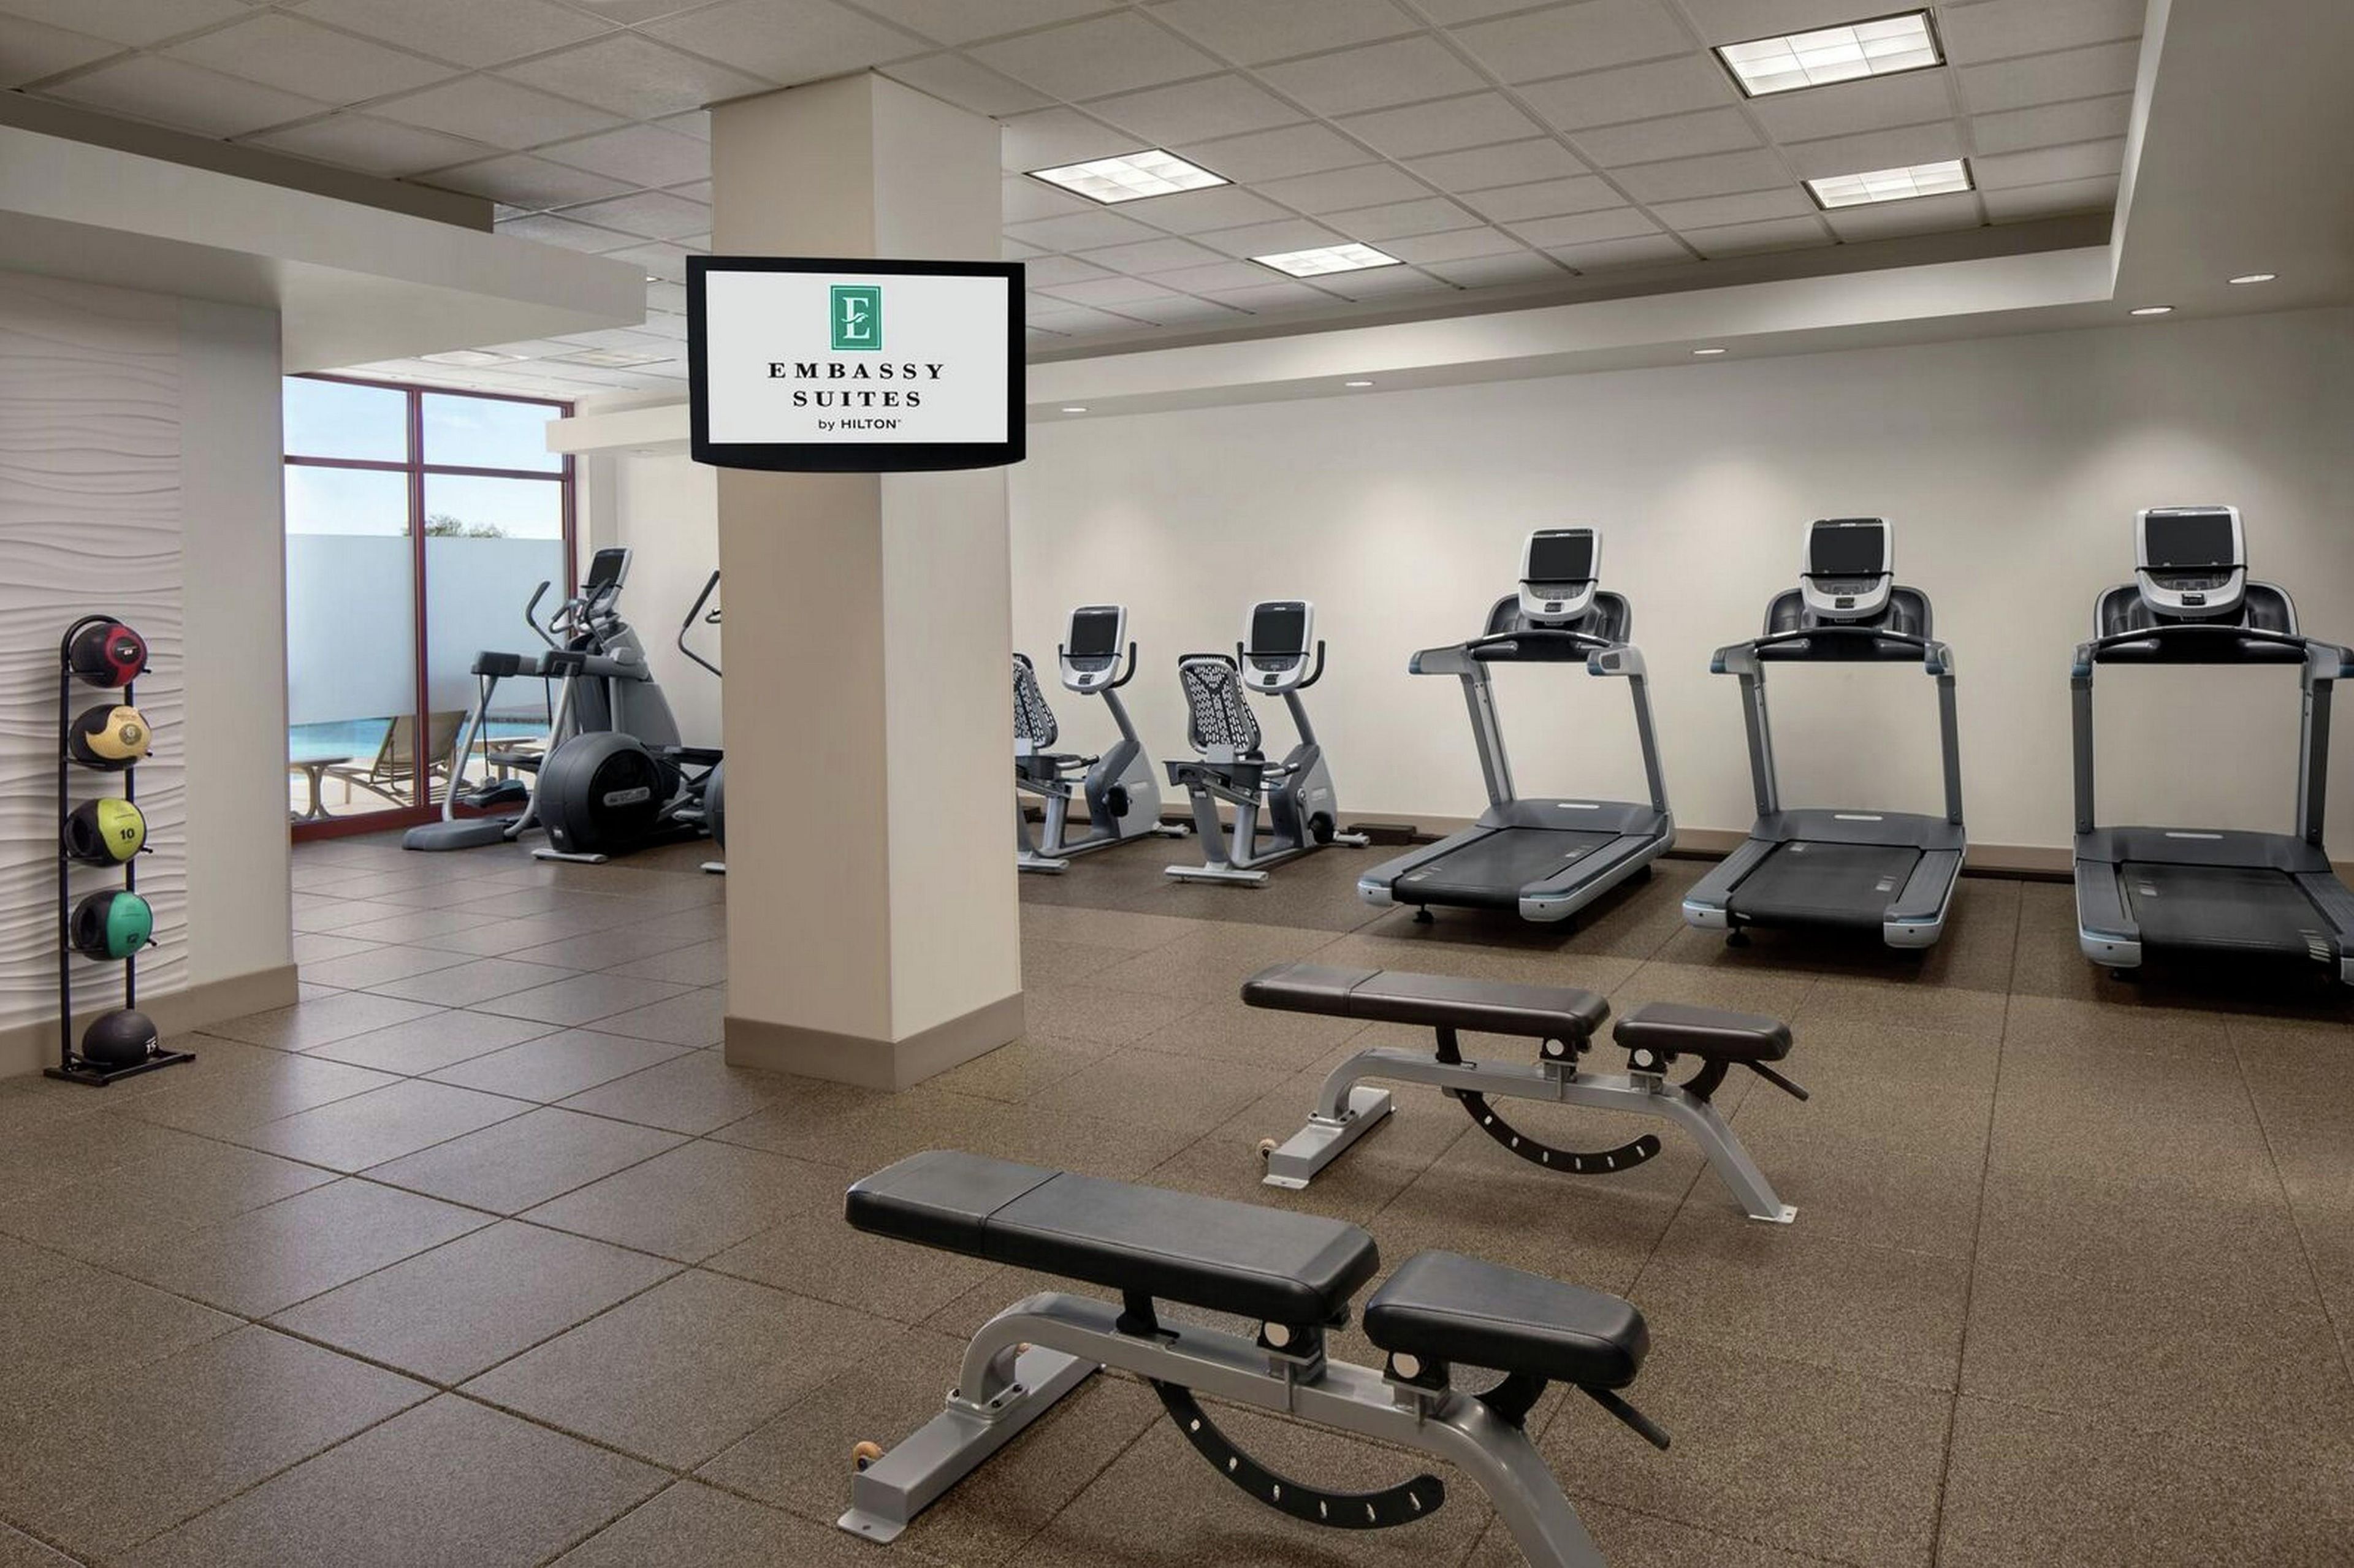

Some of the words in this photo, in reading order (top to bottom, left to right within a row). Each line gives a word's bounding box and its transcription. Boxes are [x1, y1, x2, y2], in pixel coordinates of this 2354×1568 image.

[768, 363, 943, 379] EMBASSY
[793, 390, 921, 407] SUITES
[818, 419, 835, 431] by
[841, 419, 896, 428] HILTON
[120, 828, 135, 840] 10
